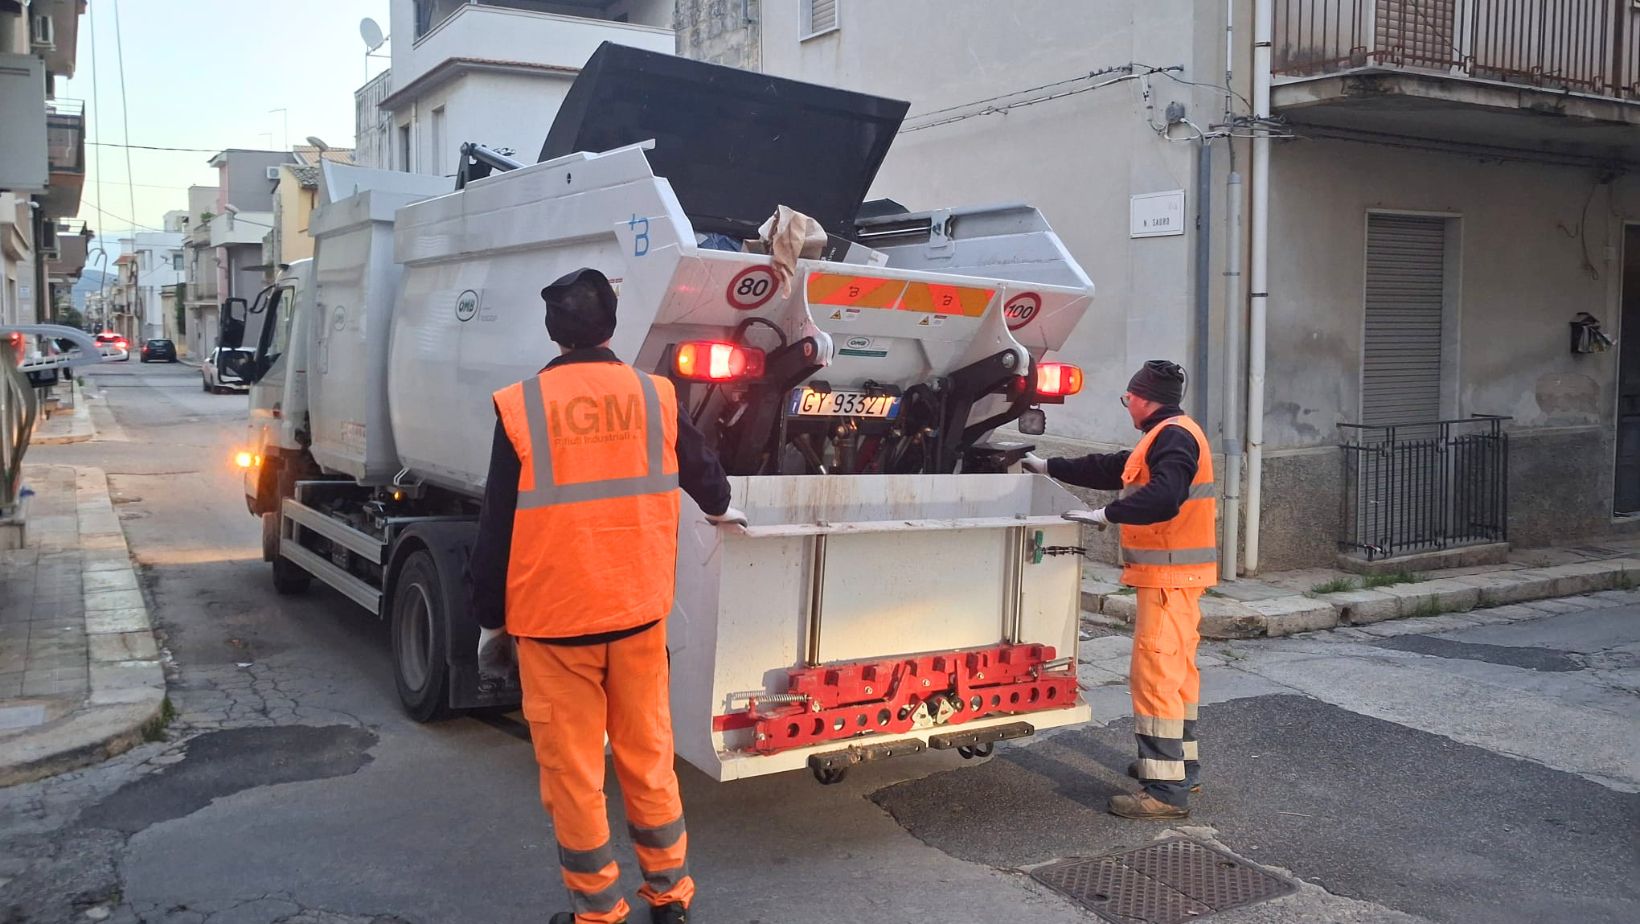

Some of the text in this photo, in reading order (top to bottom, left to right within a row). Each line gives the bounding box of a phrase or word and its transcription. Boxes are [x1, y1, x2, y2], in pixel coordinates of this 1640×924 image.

[1152, 217, 1170, 226] SAURO
[737, 277, 769, 297] 80
[1006, 304, 1034, 319] 100
[802, 392, 828, 413] GY
[550, 394, 643, 438] IGM
